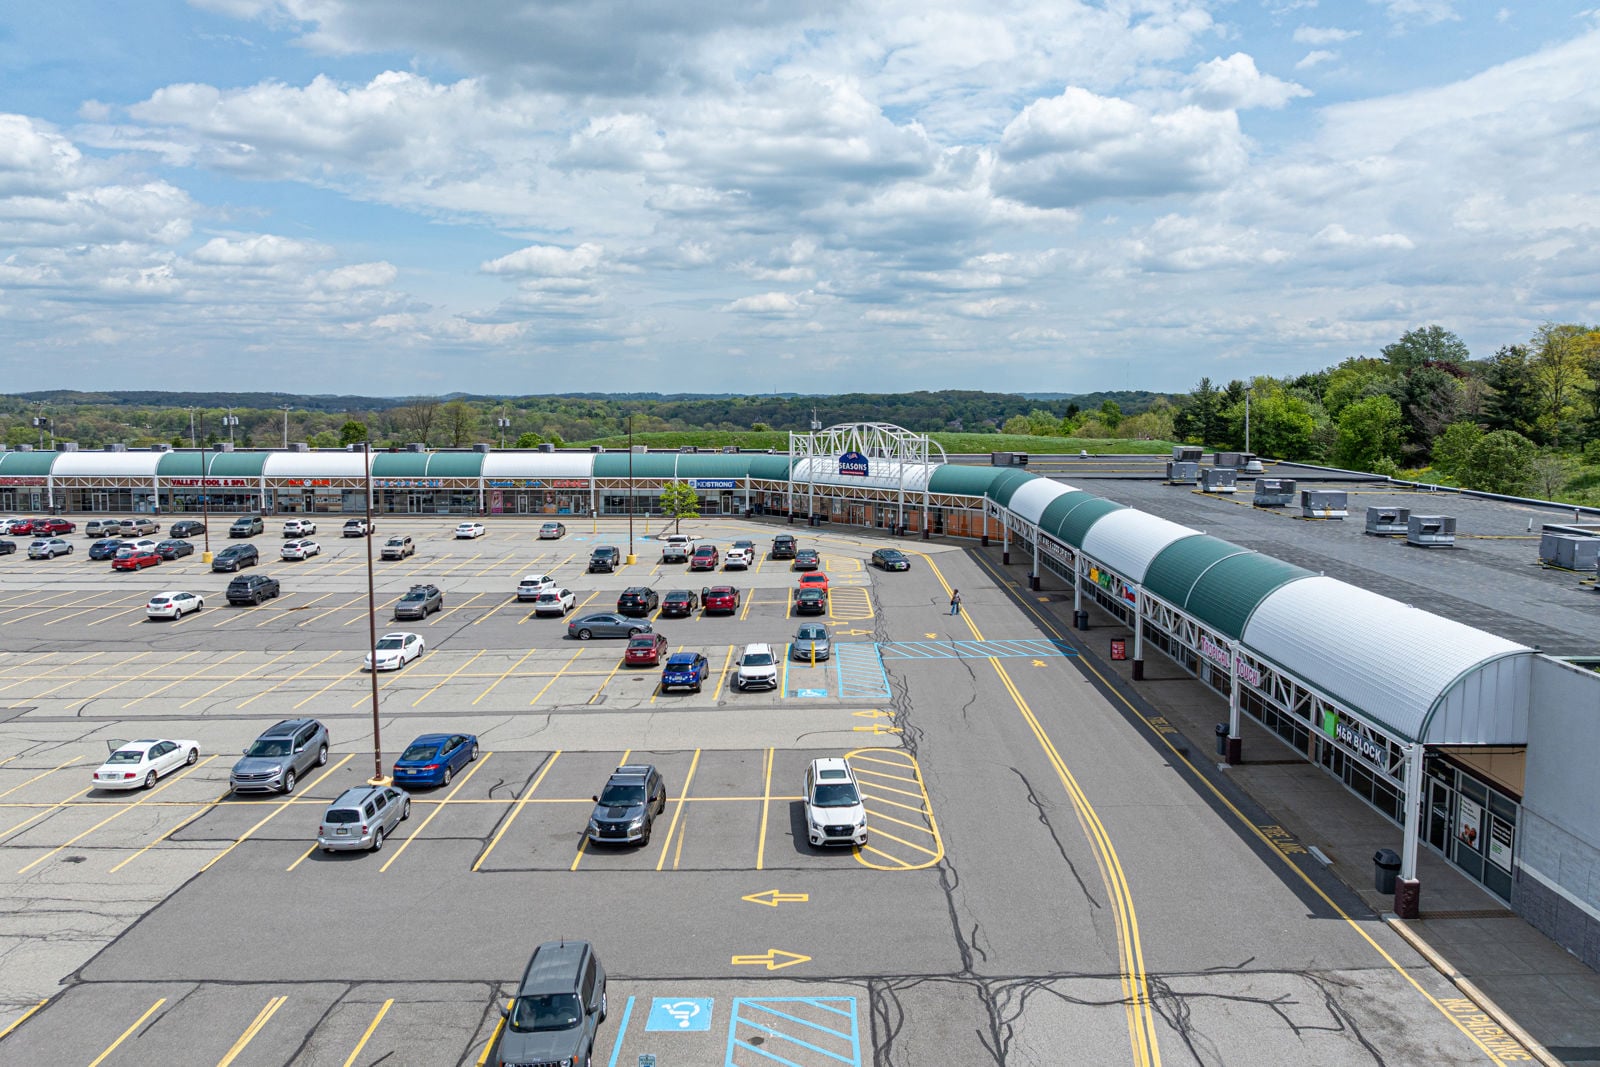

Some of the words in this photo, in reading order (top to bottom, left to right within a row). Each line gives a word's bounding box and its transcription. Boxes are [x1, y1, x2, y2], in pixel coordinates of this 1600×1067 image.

[840, 462, 867, 471] SEASONS
[1201, 635, 1229, 668] TROPICAL
[1235, 656, 1260, 687] TOUCH
[1336, 723, 1353, 744] H&R
[1353, 735, 1381, 763] BLOCK
[1438, 998, 1479, 1013] NO
[1456, 1014, 1532, 1061] PARKING
